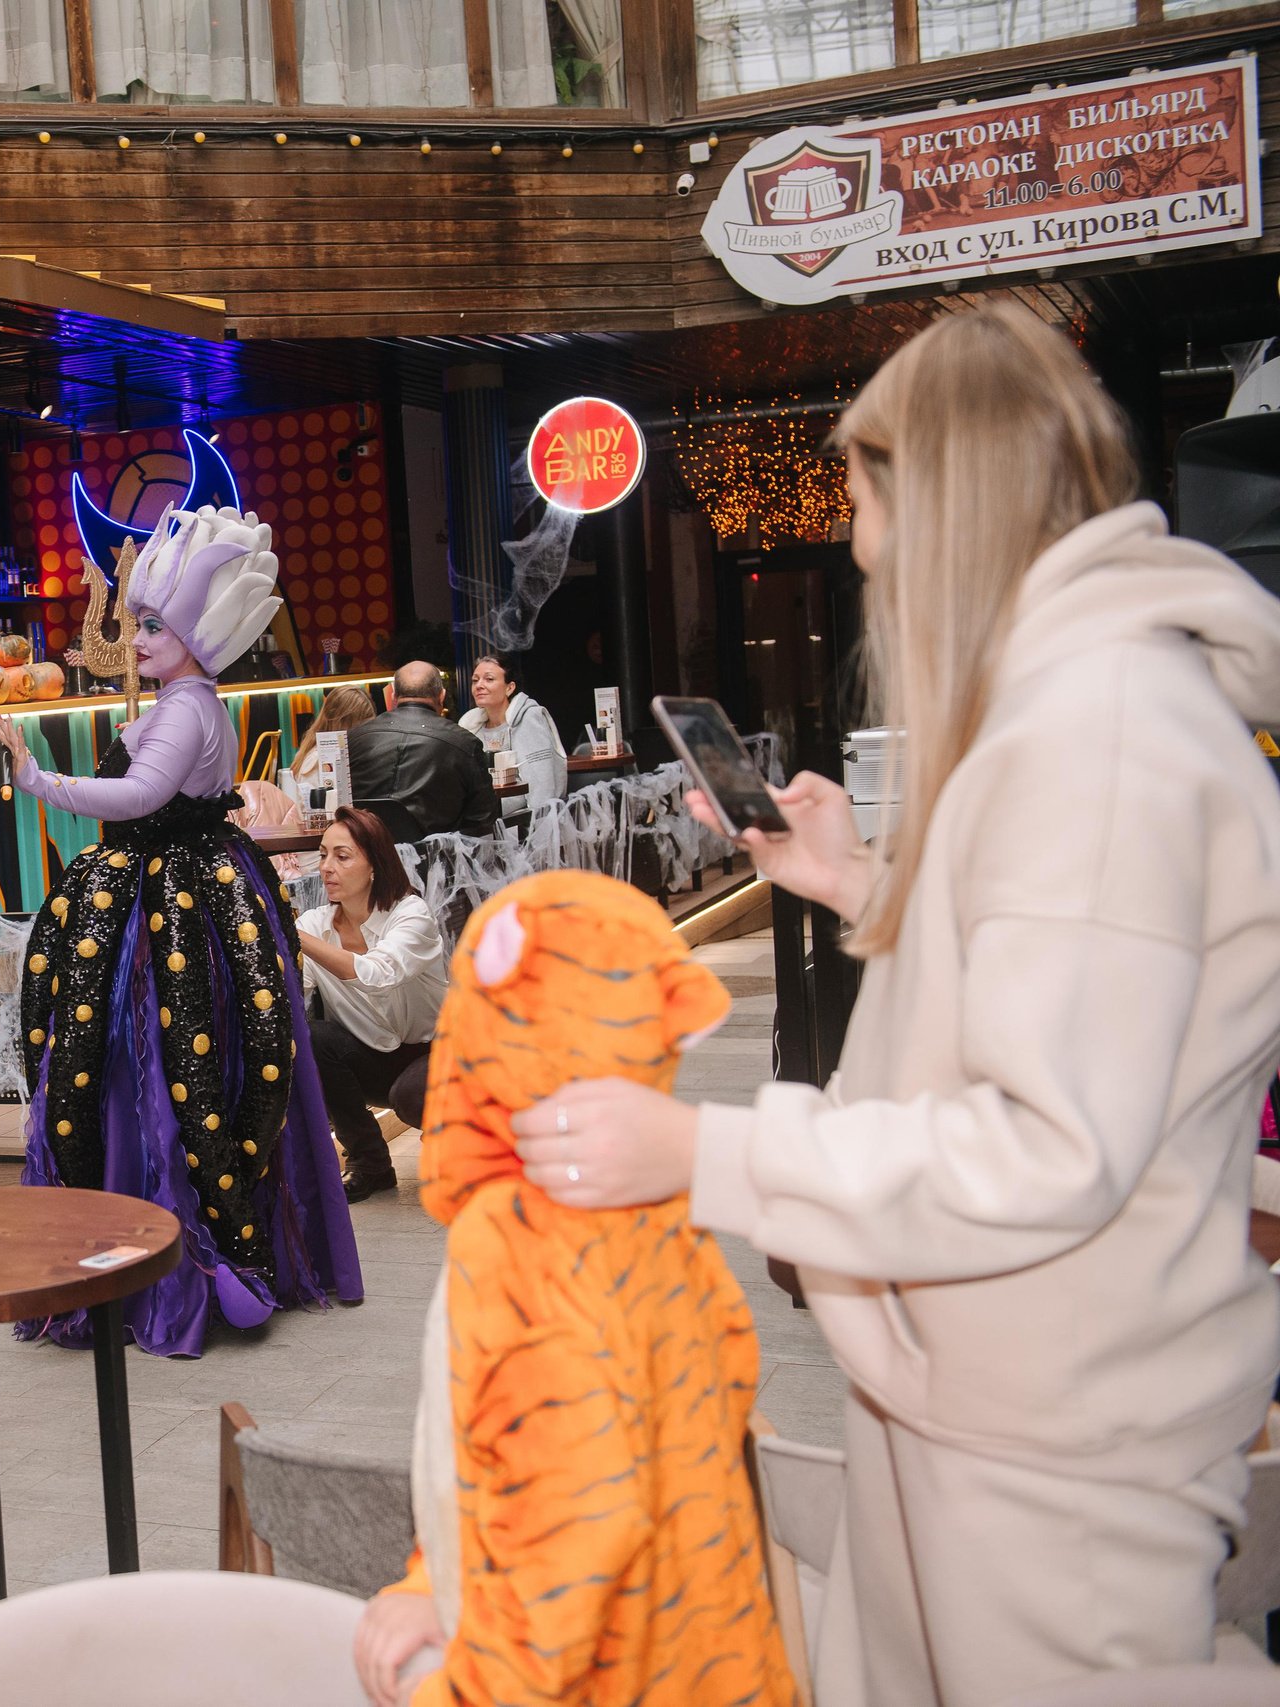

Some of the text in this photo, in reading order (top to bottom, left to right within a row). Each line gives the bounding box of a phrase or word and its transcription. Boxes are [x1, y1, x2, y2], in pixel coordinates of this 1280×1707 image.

[901, 87, 1206, 157] РЕСТОРАН БИЛЬЯРД
[911, 120, 1230, 191] КАРАОКЕ ДИСКОТЕКА
[733, 211, 887, 248] Пивной бульвар
[875, 239, 949, 268] вход
[978, 229, 1024, 260] ул.
[1032, 203, 1160, 245] Кирова
[1168, 190, 1238, 224] С.М.
[798, 251, 823, 264] 2004
[543, 425, 625, 459] ANDY
[545, 455, 608, 485] BAR
